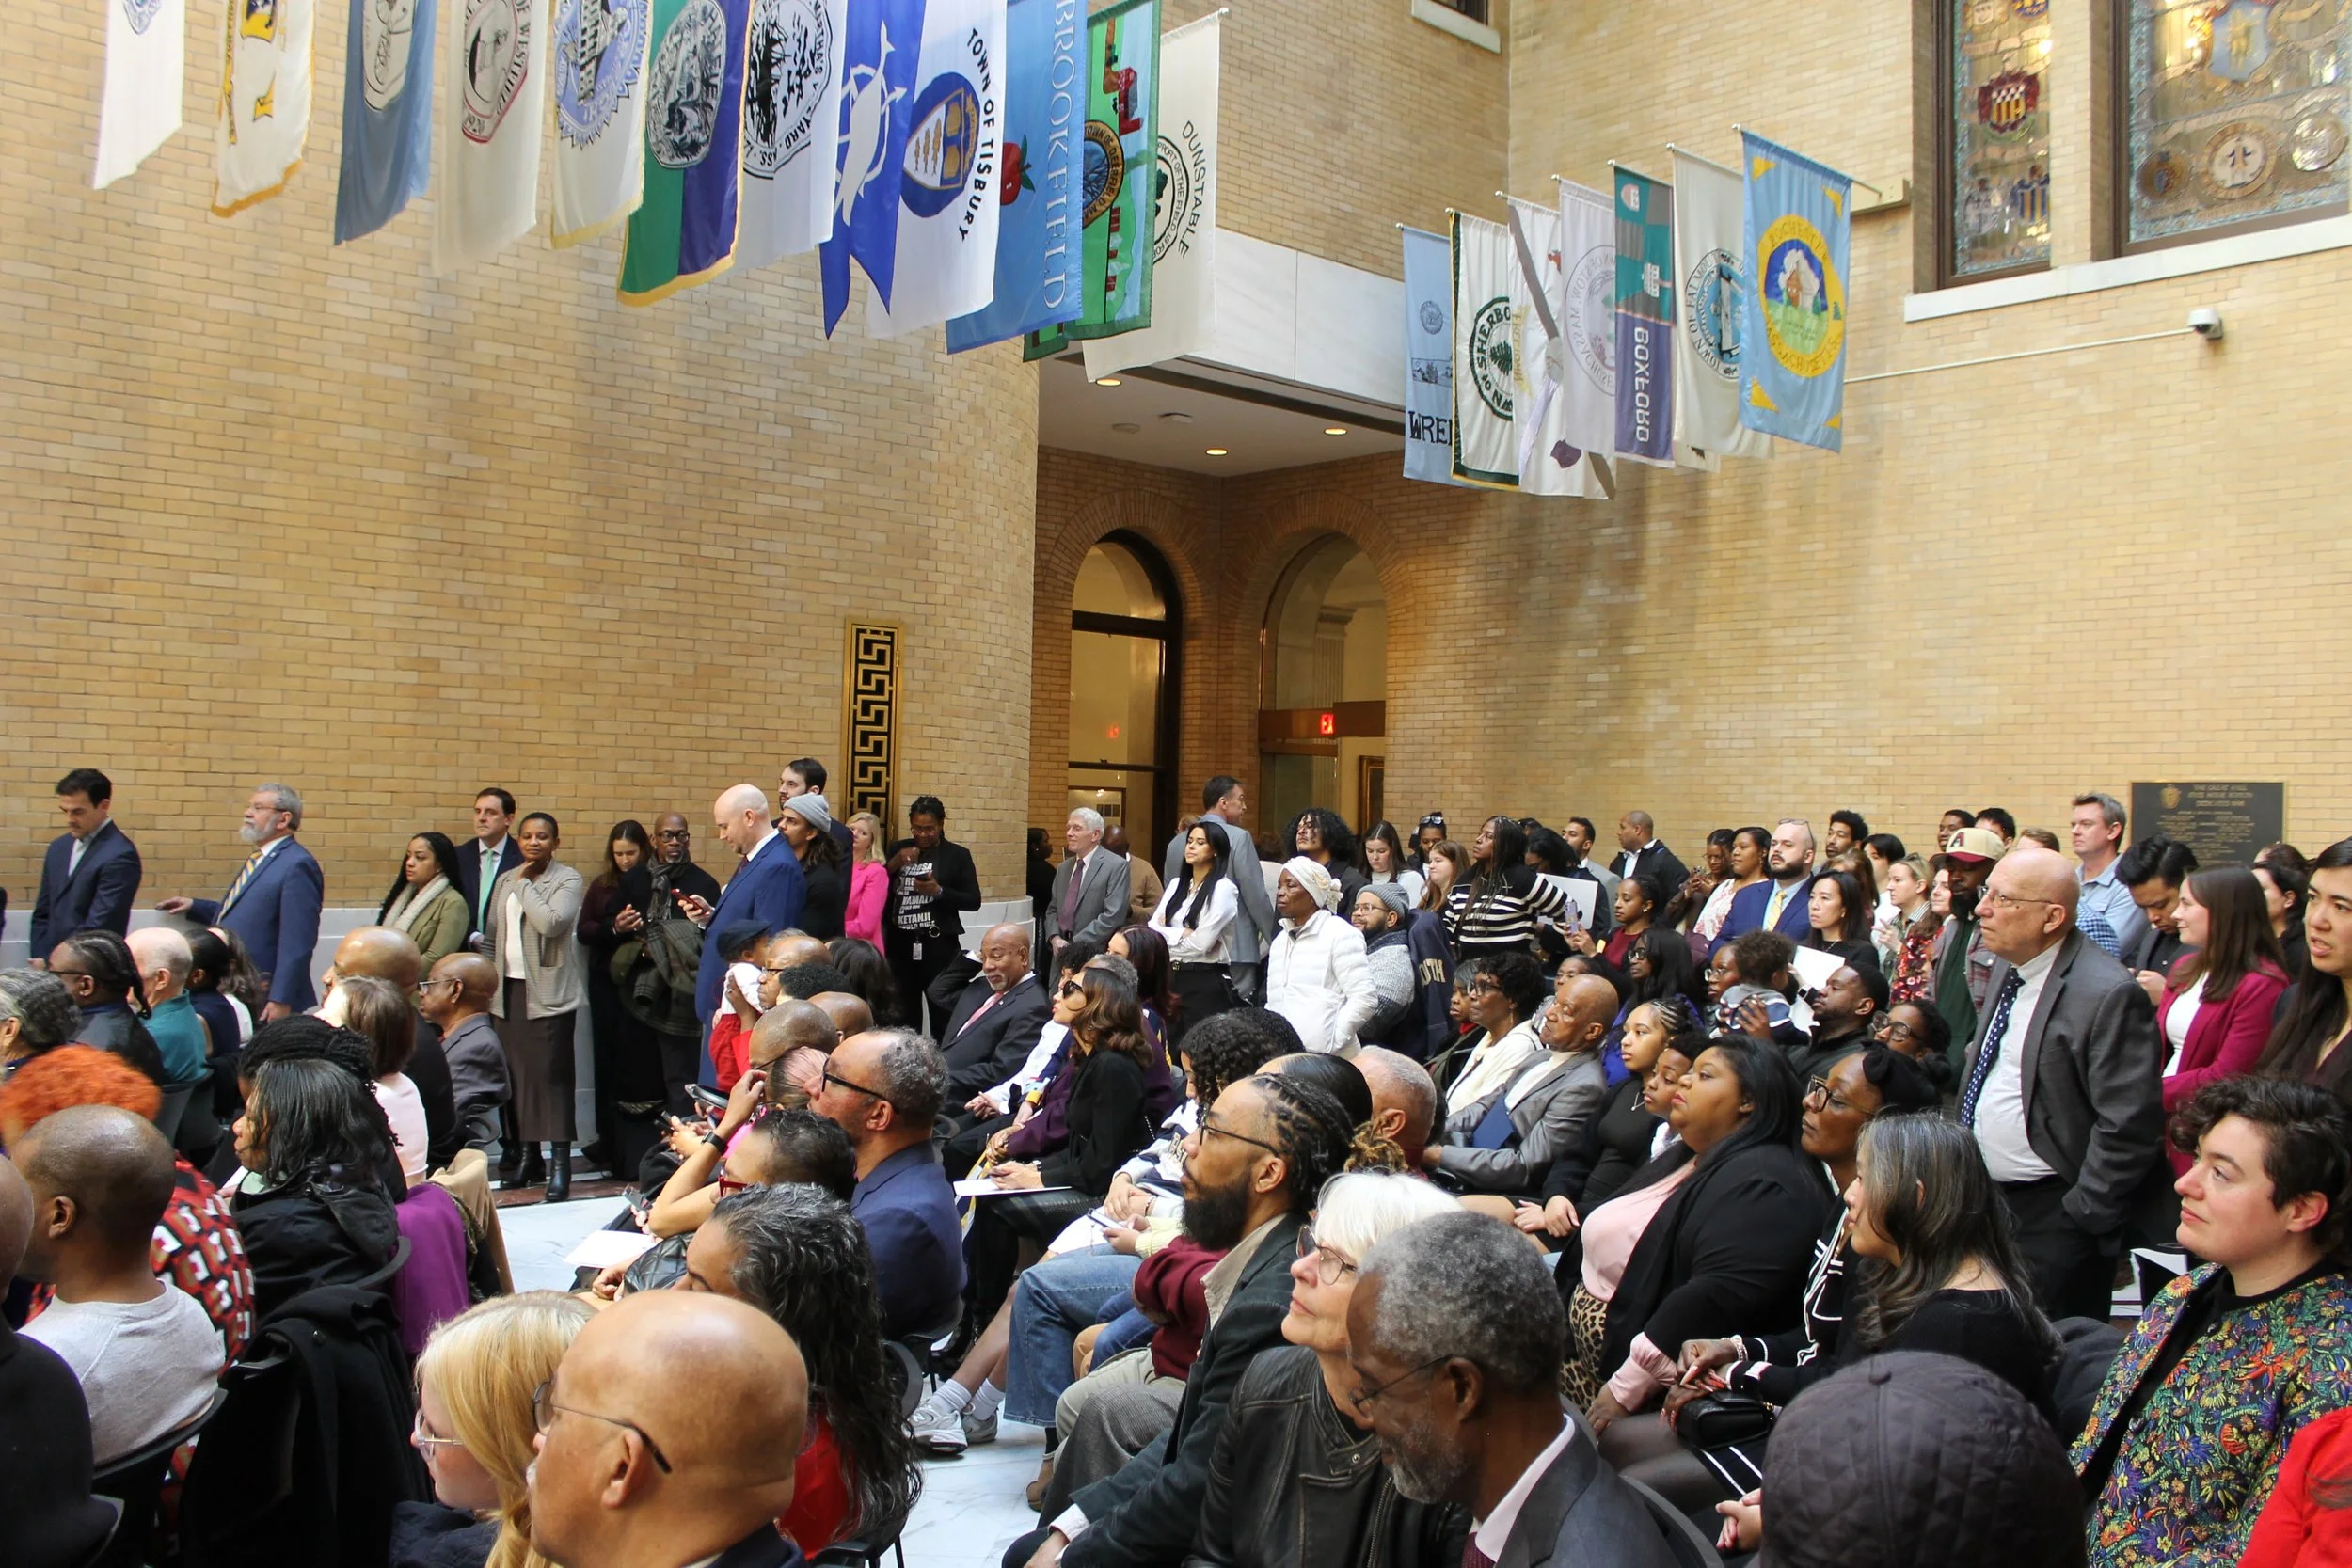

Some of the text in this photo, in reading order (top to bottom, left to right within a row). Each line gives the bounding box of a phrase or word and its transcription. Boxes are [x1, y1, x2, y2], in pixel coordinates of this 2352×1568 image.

[966, 27, 991, 93] TOWN
[785, 82, 819, 150] VYARD
[982, 99, 995, 128] OF
[1085, 125, 1104, 140] TOWN
[1104, 135, 1114, 146] OF
[1042, 0, 1076, 310] BROOKFIELD
[1174, 162, 1183, 176] OF
[958, 137, 993, 243] TISBURY
[1099, 147, 1120, 206] DEERFIELD
[1176, 176, 1184, 198] THE
[1178, 120, 1206, 259] DUNSTABLE
[1170, 199, 1183, 231] FIELD
[1689, 318, 1698, 333] OF
[1695, 338, 1721, 371] TOWN
[1633, 326, 1650, 443] BOXFORD
[1949, 832, 1964, 847] A
[898, 911, 931, 925] KETANJI
